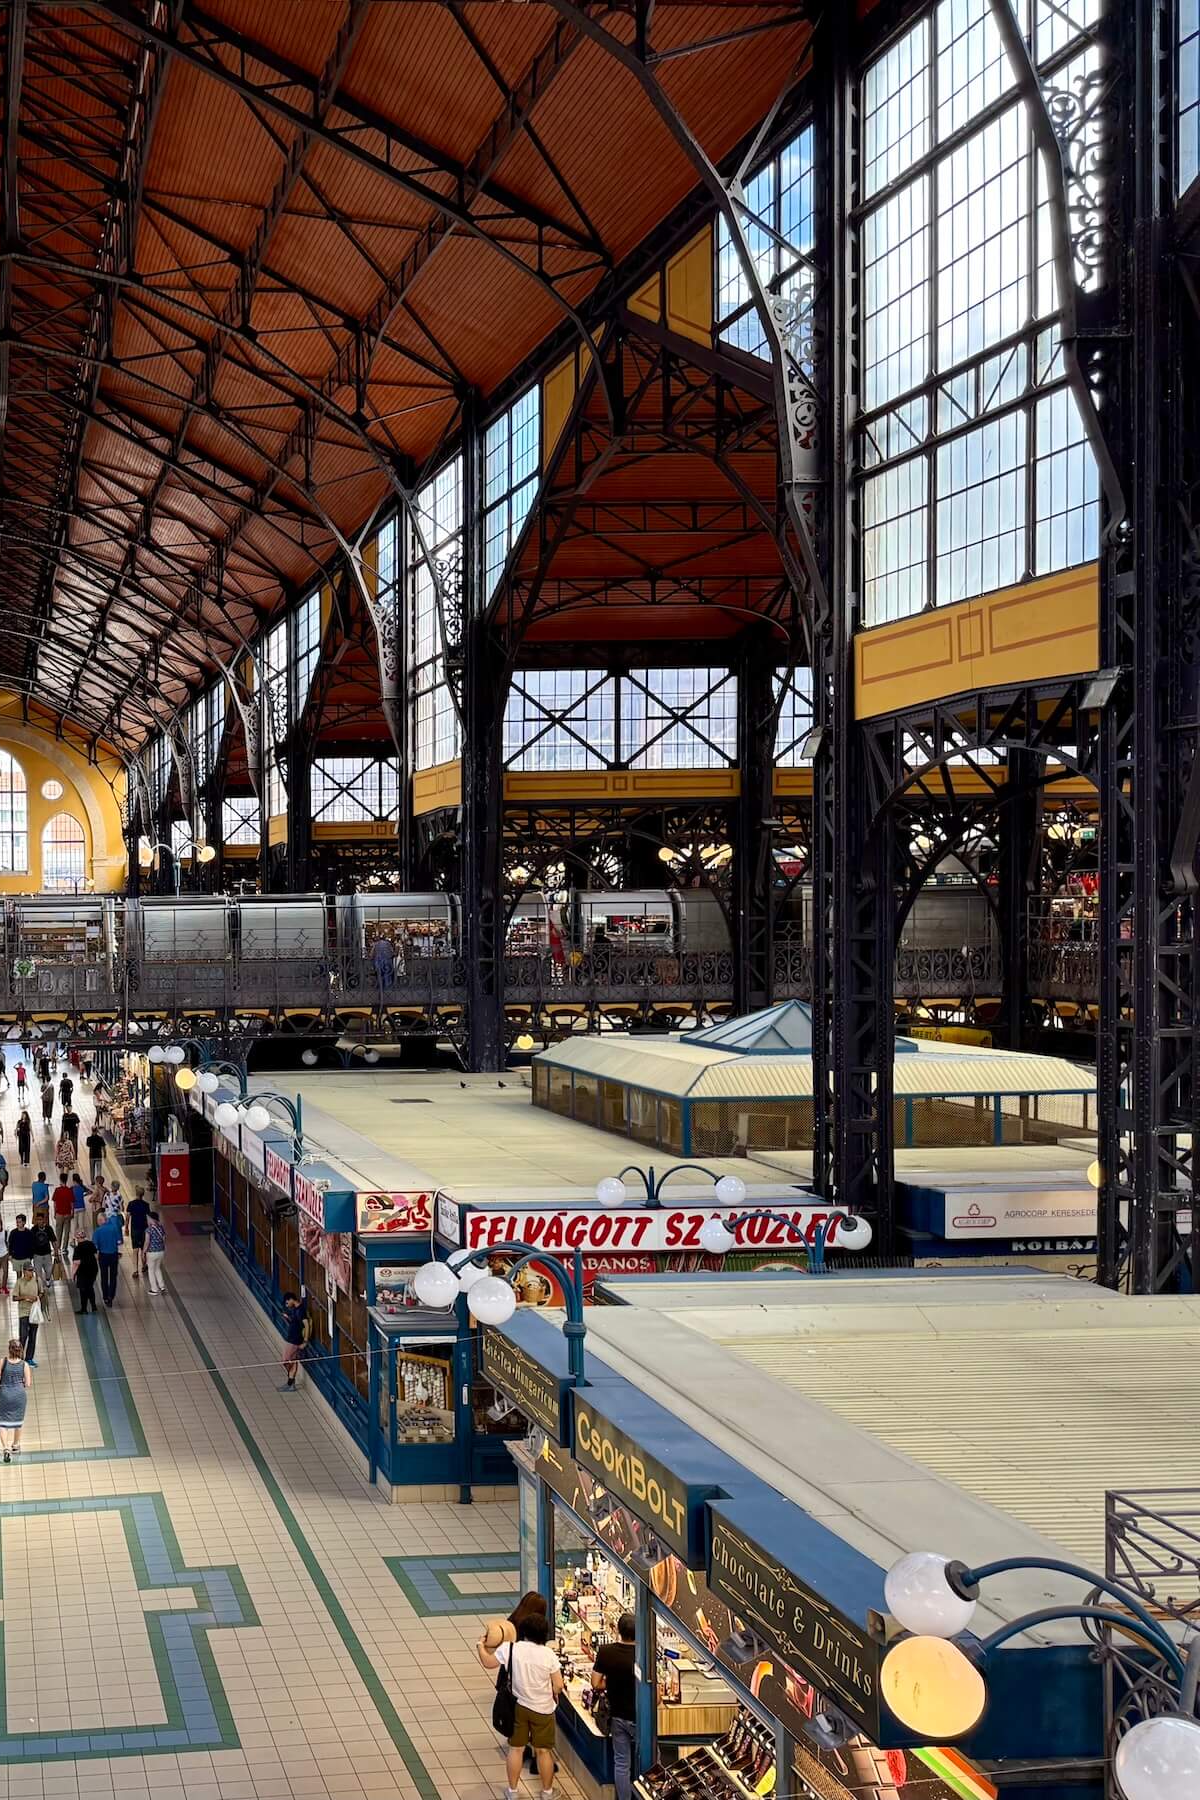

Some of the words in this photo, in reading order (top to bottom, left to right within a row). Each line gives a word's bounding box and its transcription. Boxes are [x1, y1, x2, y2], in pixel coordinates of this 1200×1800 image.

[469, 1212, 653, 1249] FELVÁGOTT
[665, 1208, 843, 1246] SZKÜZLET
[1011, 1239, 1096, 1251] KOLBÁS
[712, 1536, 785, 1619] Chocolate
[793, 1606, 805, 1634] &
[813, 1622, 873, 1696] Drinks
